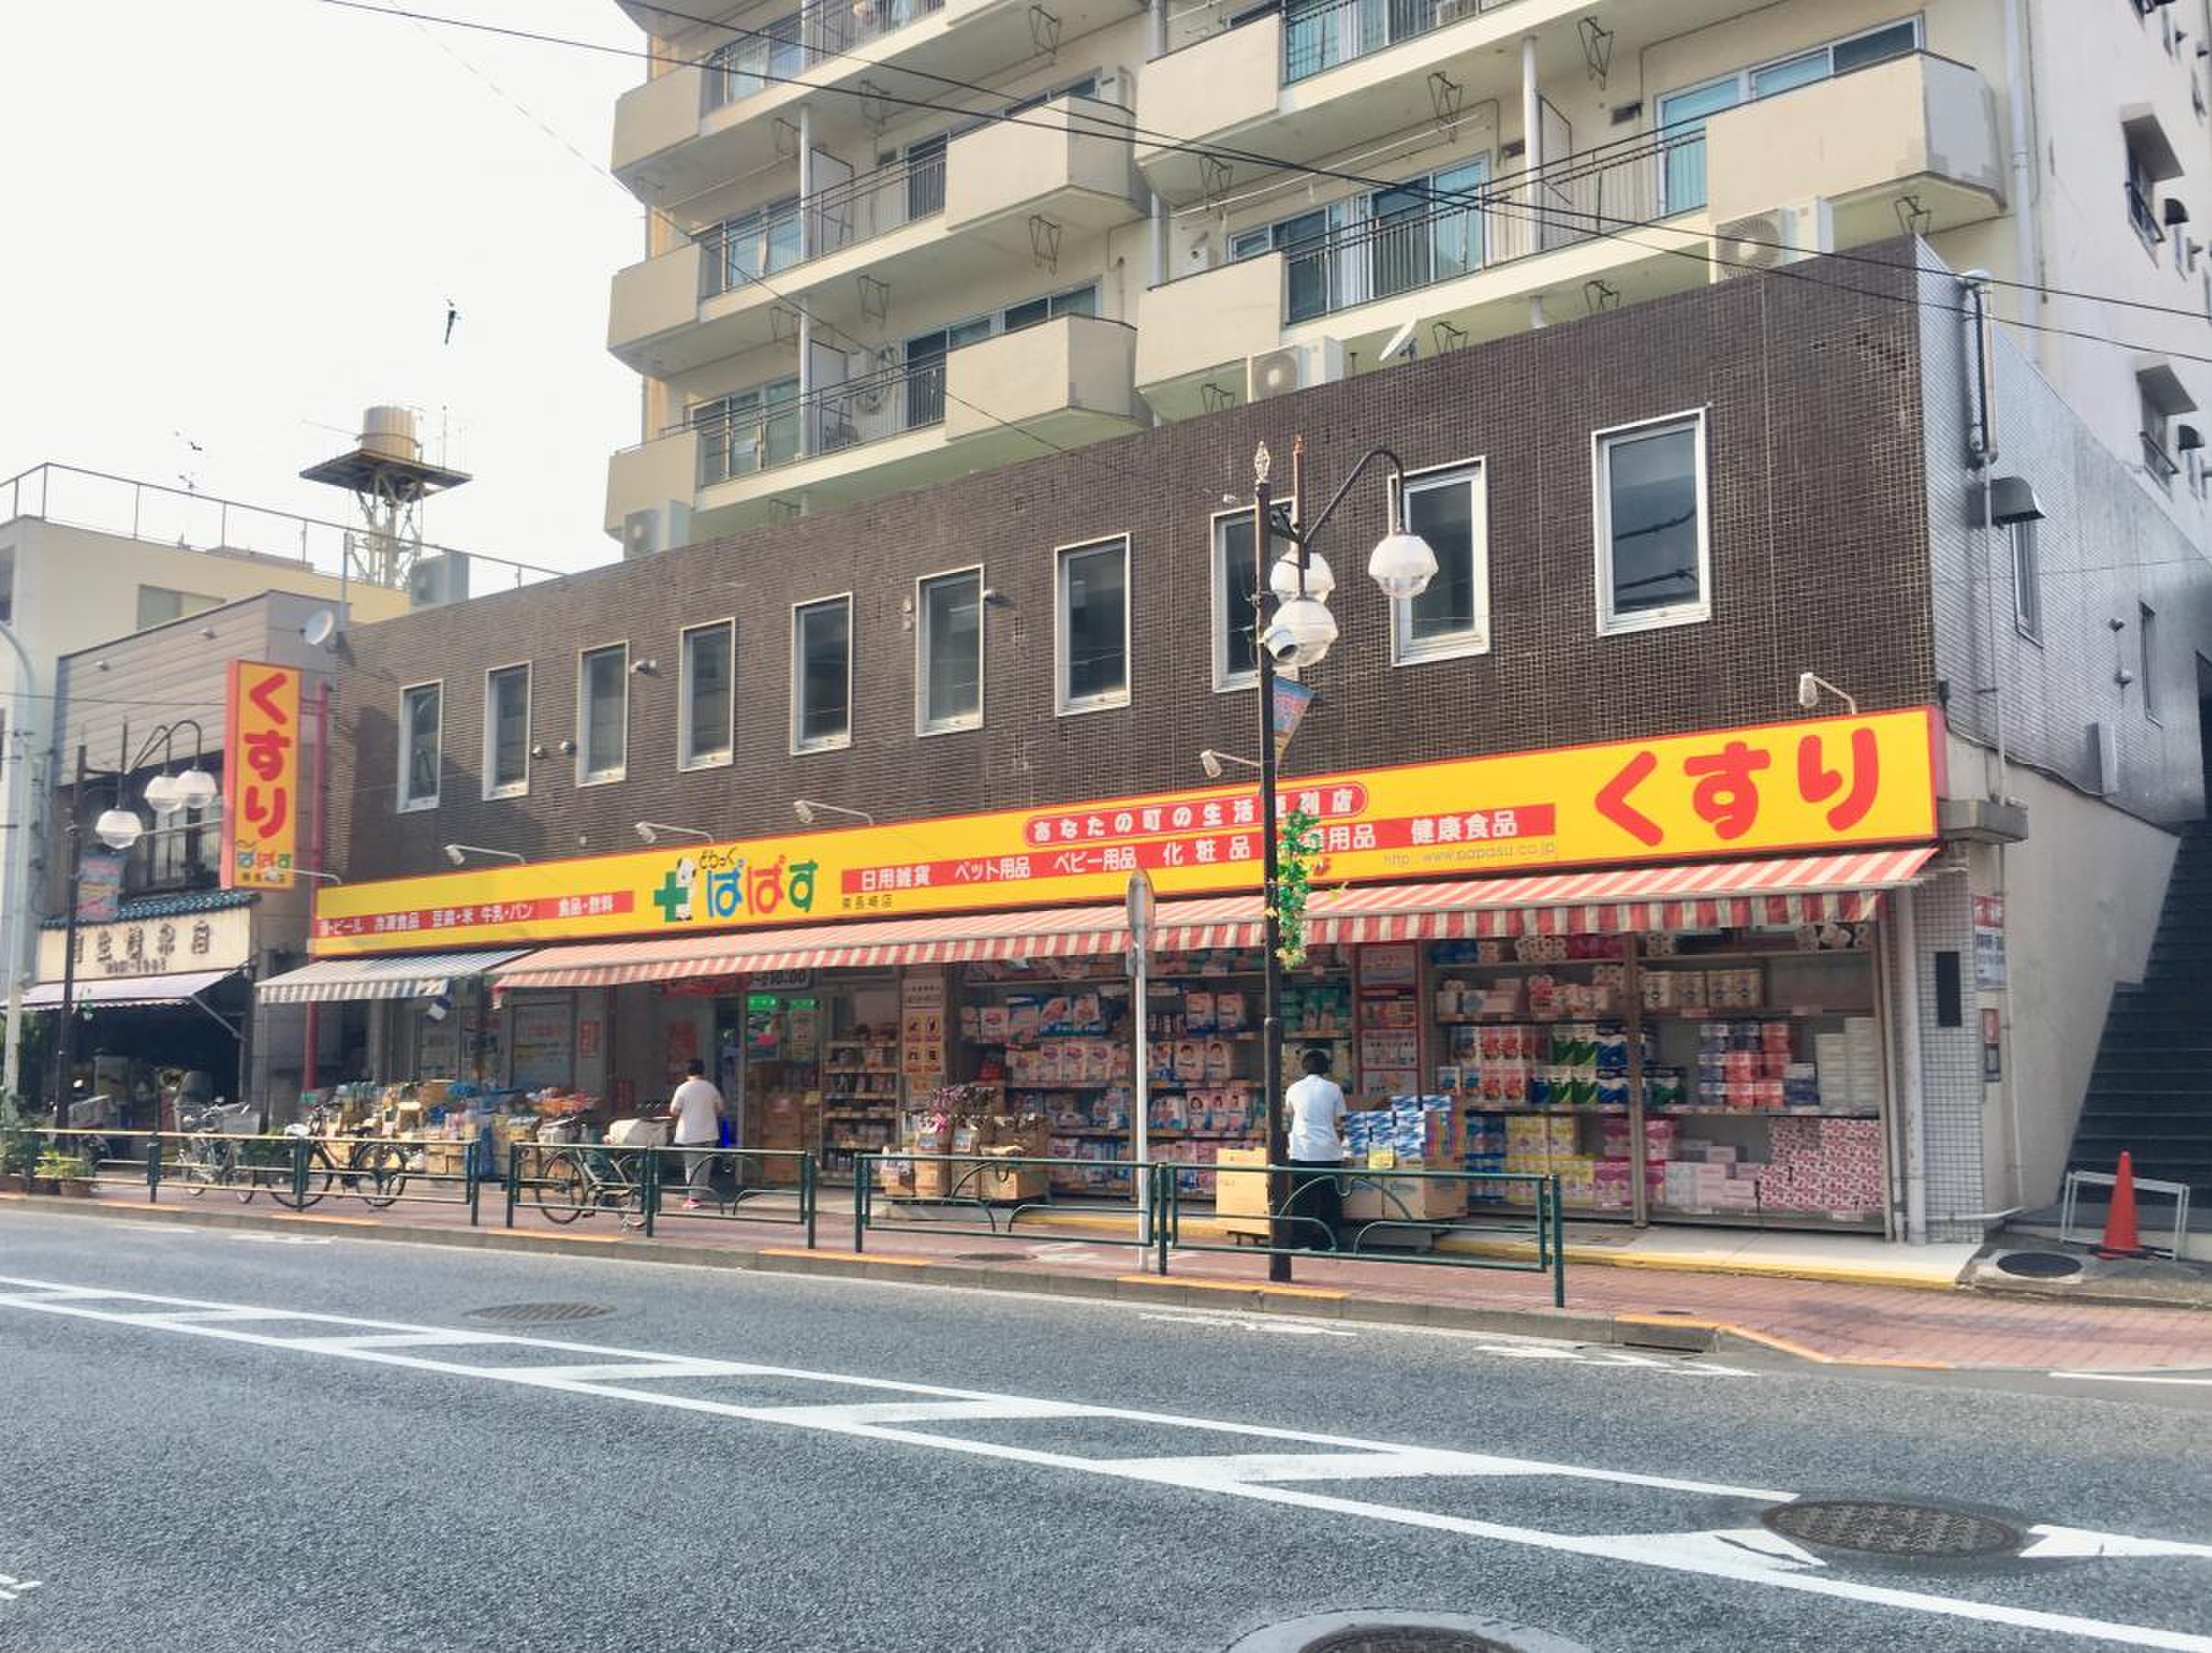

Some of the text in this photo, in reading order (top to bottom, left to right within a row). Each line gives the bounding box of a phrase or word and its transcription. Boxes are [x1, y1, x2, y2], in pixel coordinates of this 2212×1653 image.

[243, 672, 292, 838] くすり
[1595, 726, 1879, 847] くすり
[1411, 810, 1518, 846] 健康食品
[706, 854, 819, 918] ぱぱす
[861, 835, 1251, 893] 日用雑貨 ペット用品 ベビー用品 化粧品
